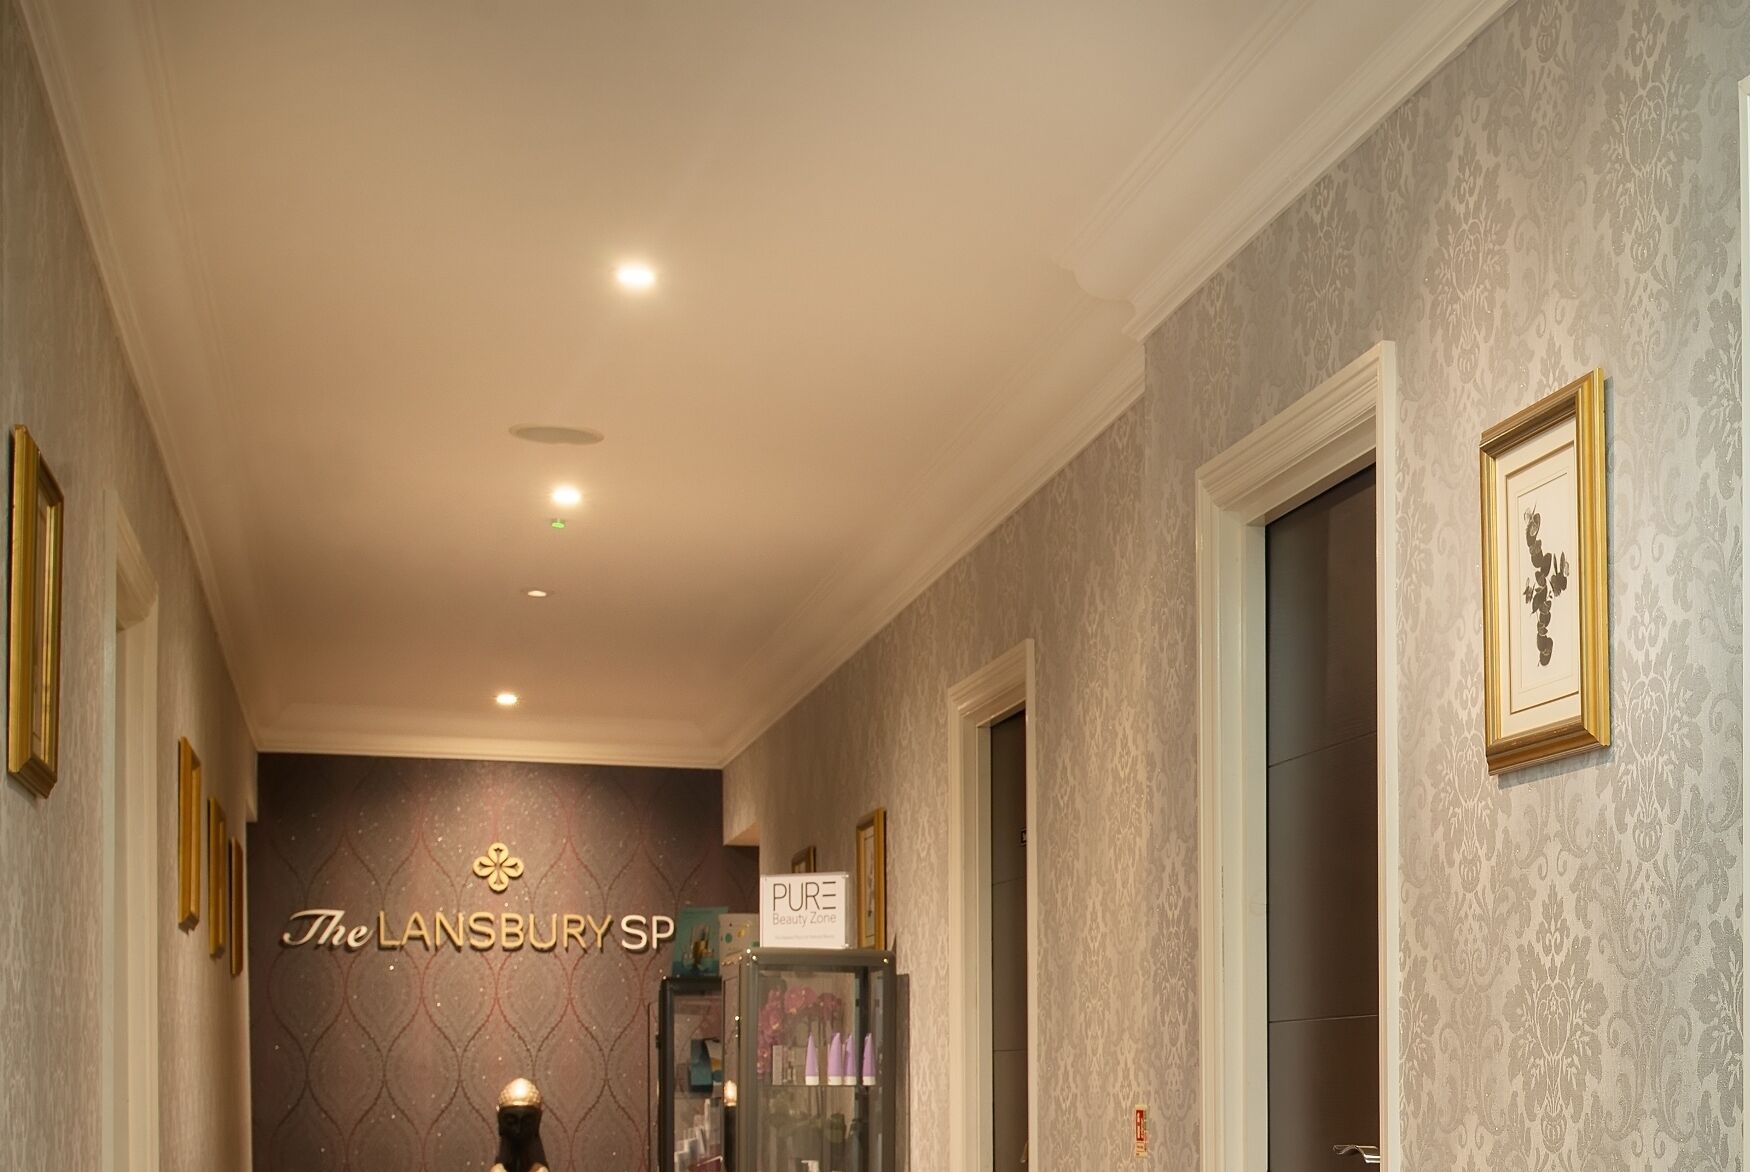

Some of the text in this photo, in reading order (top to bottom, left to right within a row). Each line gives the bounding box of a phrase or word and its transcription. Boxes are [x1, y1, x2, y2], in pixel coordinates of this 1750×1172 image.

[773, 881, 836, 911] PURE
[282, 909, 375, 948] The
[379, 910, 612, 951] LANSBURY
[773, 911, 837, 928] Beauty Zone
